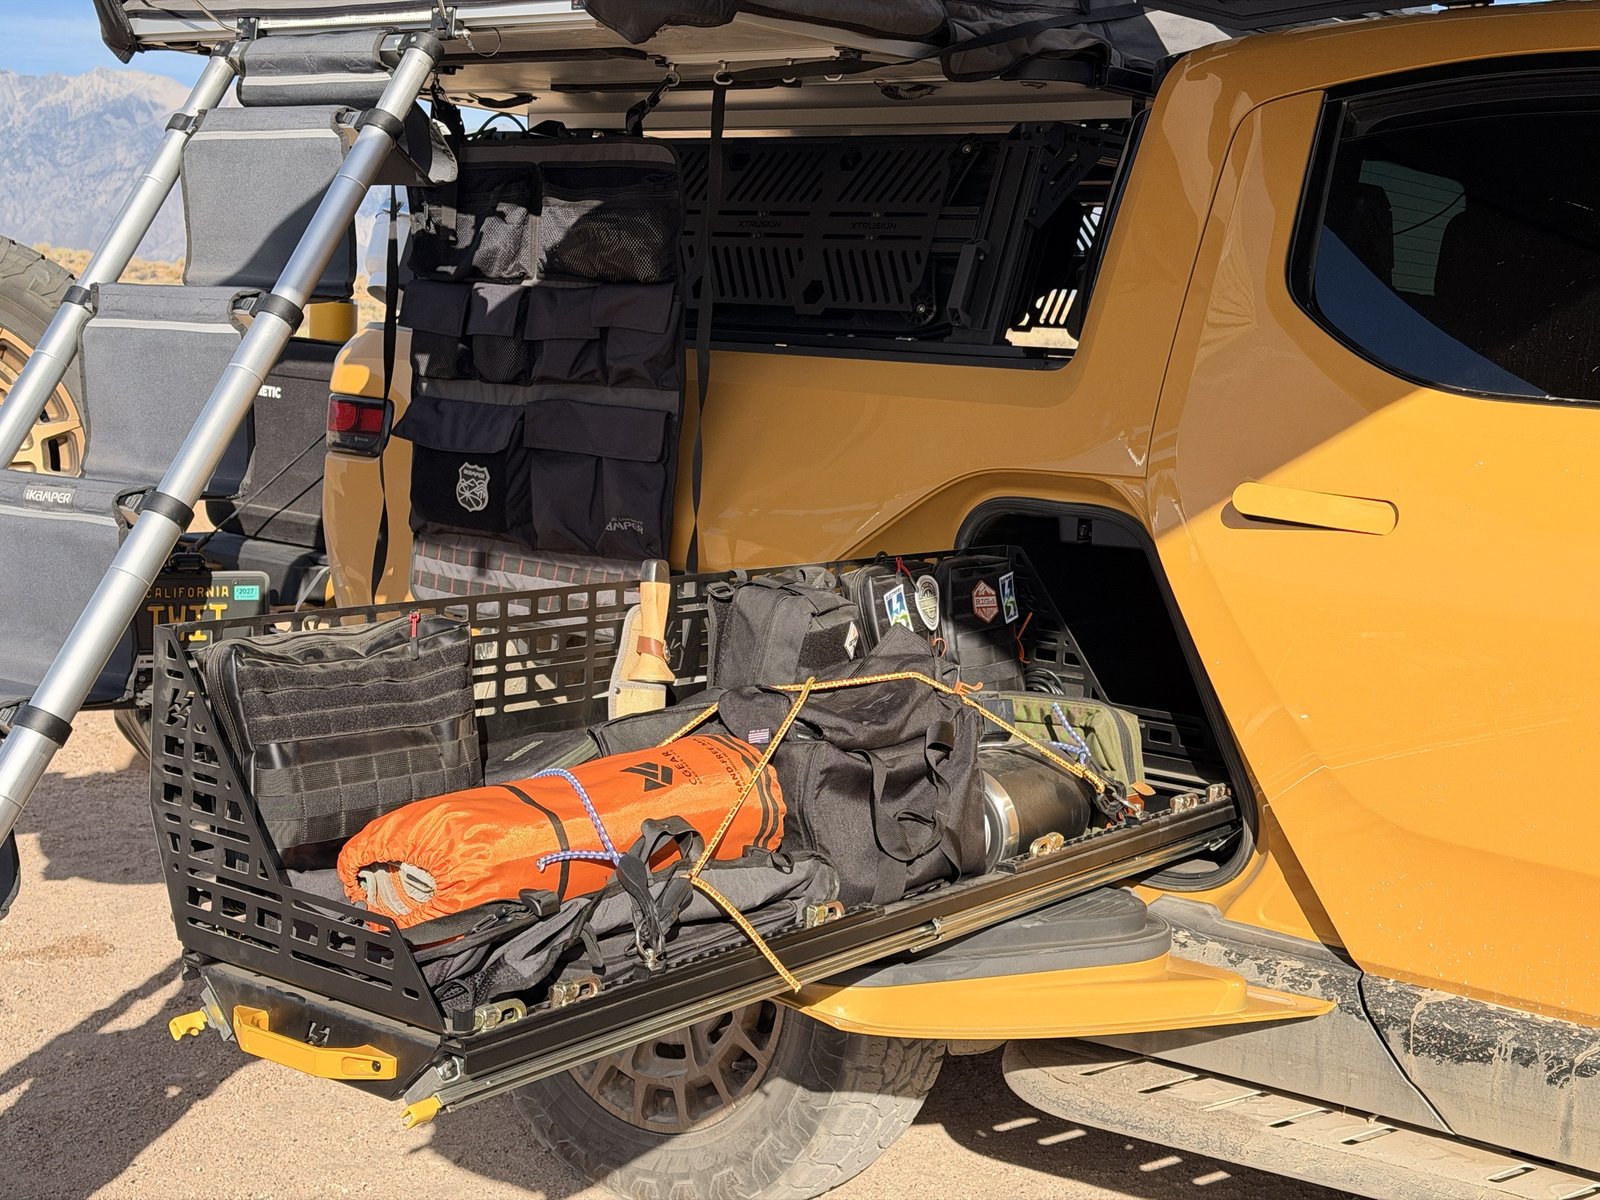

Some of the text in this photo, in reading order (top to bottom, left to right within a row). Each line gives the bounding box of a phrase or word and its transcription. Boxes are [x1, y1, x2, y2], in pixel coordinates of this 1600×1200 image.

[738, 220, 782, 228] XTRUSION
[850, 222, 897, 230] XTRUSION
[145, 586, 229, 599] CALIFORNIA
[661, 751, 698, 786] CGEAR
[706, 747, 743, 793] SAND-FREE
